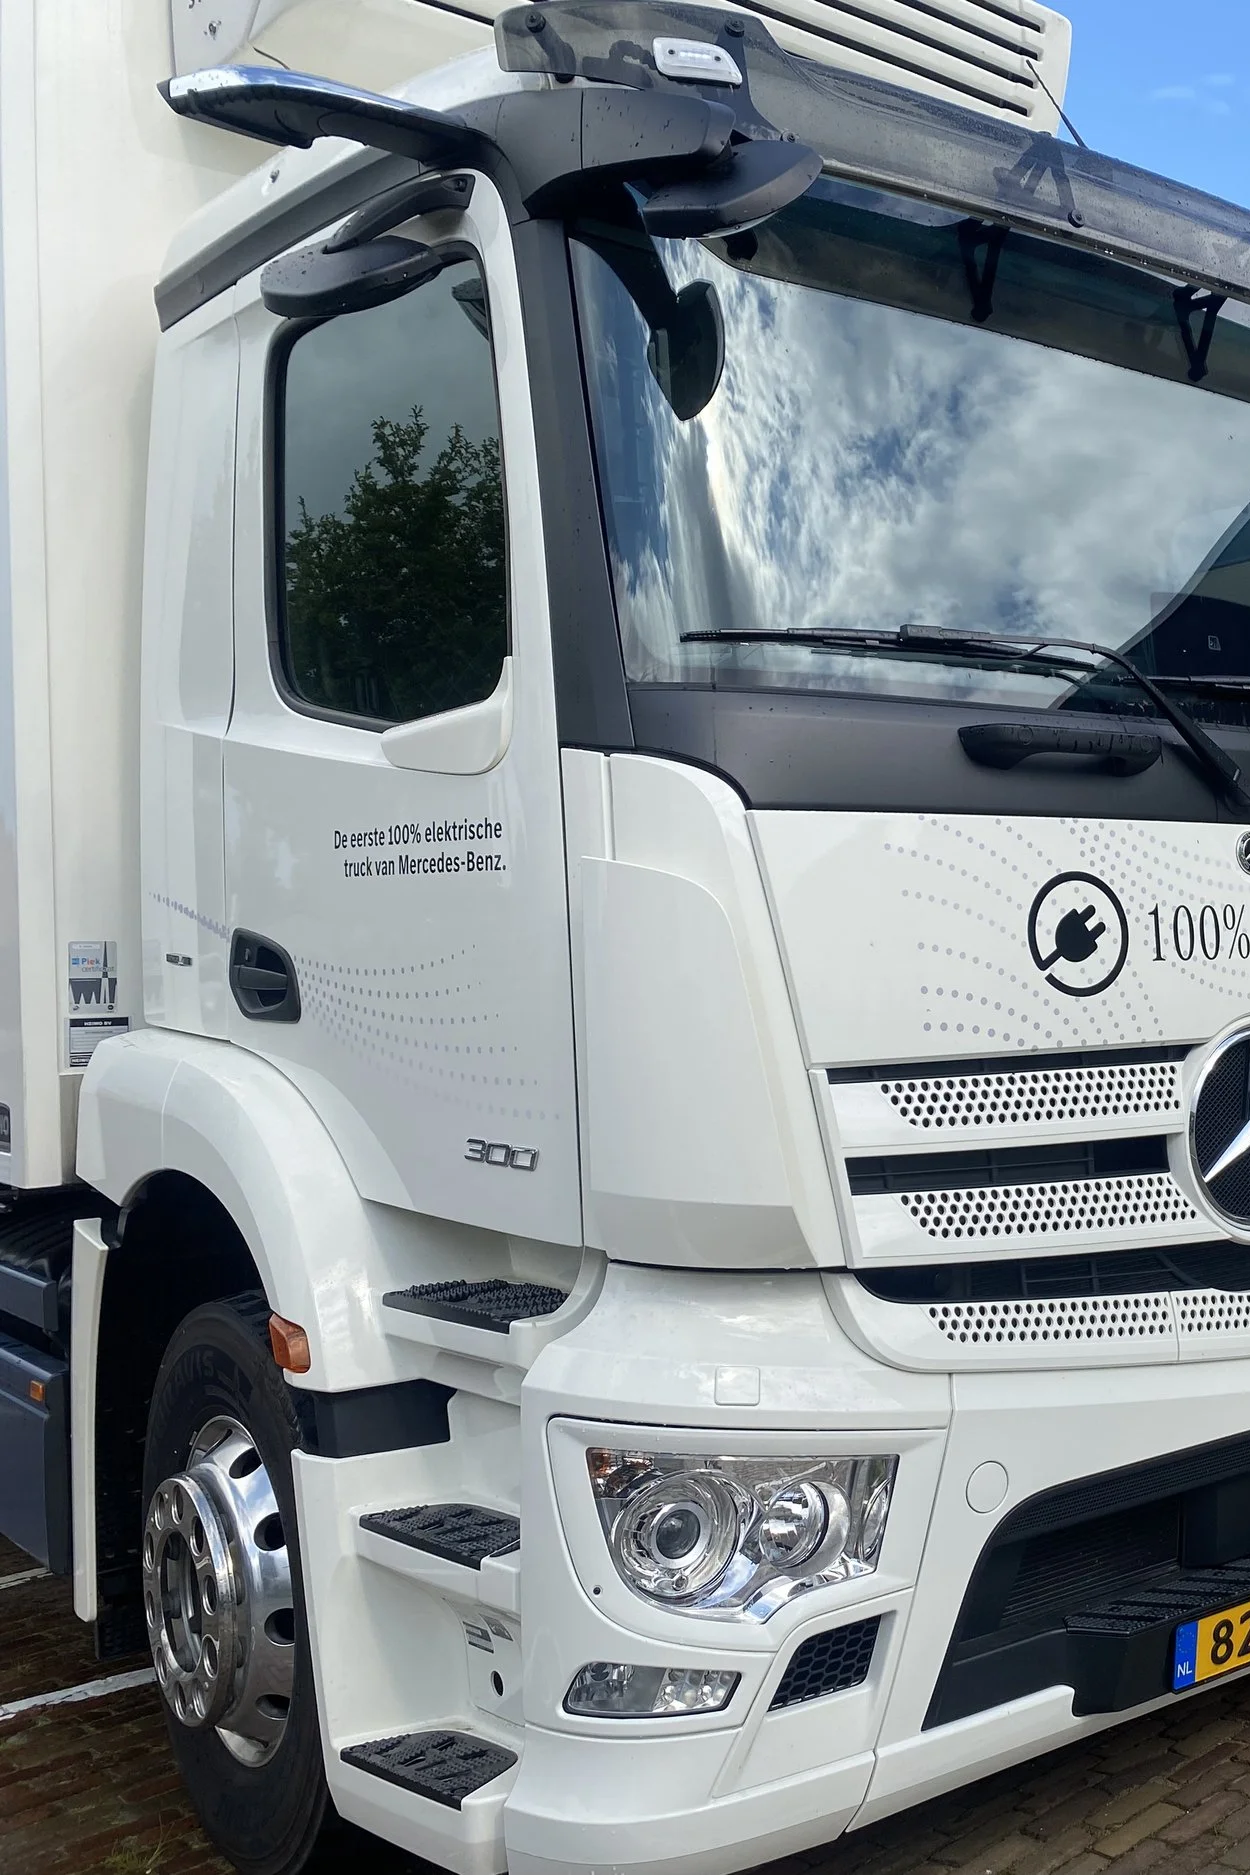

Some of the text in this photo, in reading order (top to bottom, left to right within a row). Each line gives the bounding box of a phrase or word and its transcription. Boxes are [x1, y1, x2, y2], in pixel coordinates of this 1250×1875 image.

[333, 817, 503, 850] De eerste 100% elektrische
[343, 850, 507, 878] truck van Mercedes-Benz.
[1147, 902, 1250, 962] 100%
[463, 1138, 540, 1172] 300
[1176, 1660, 1193, 1678] NL
